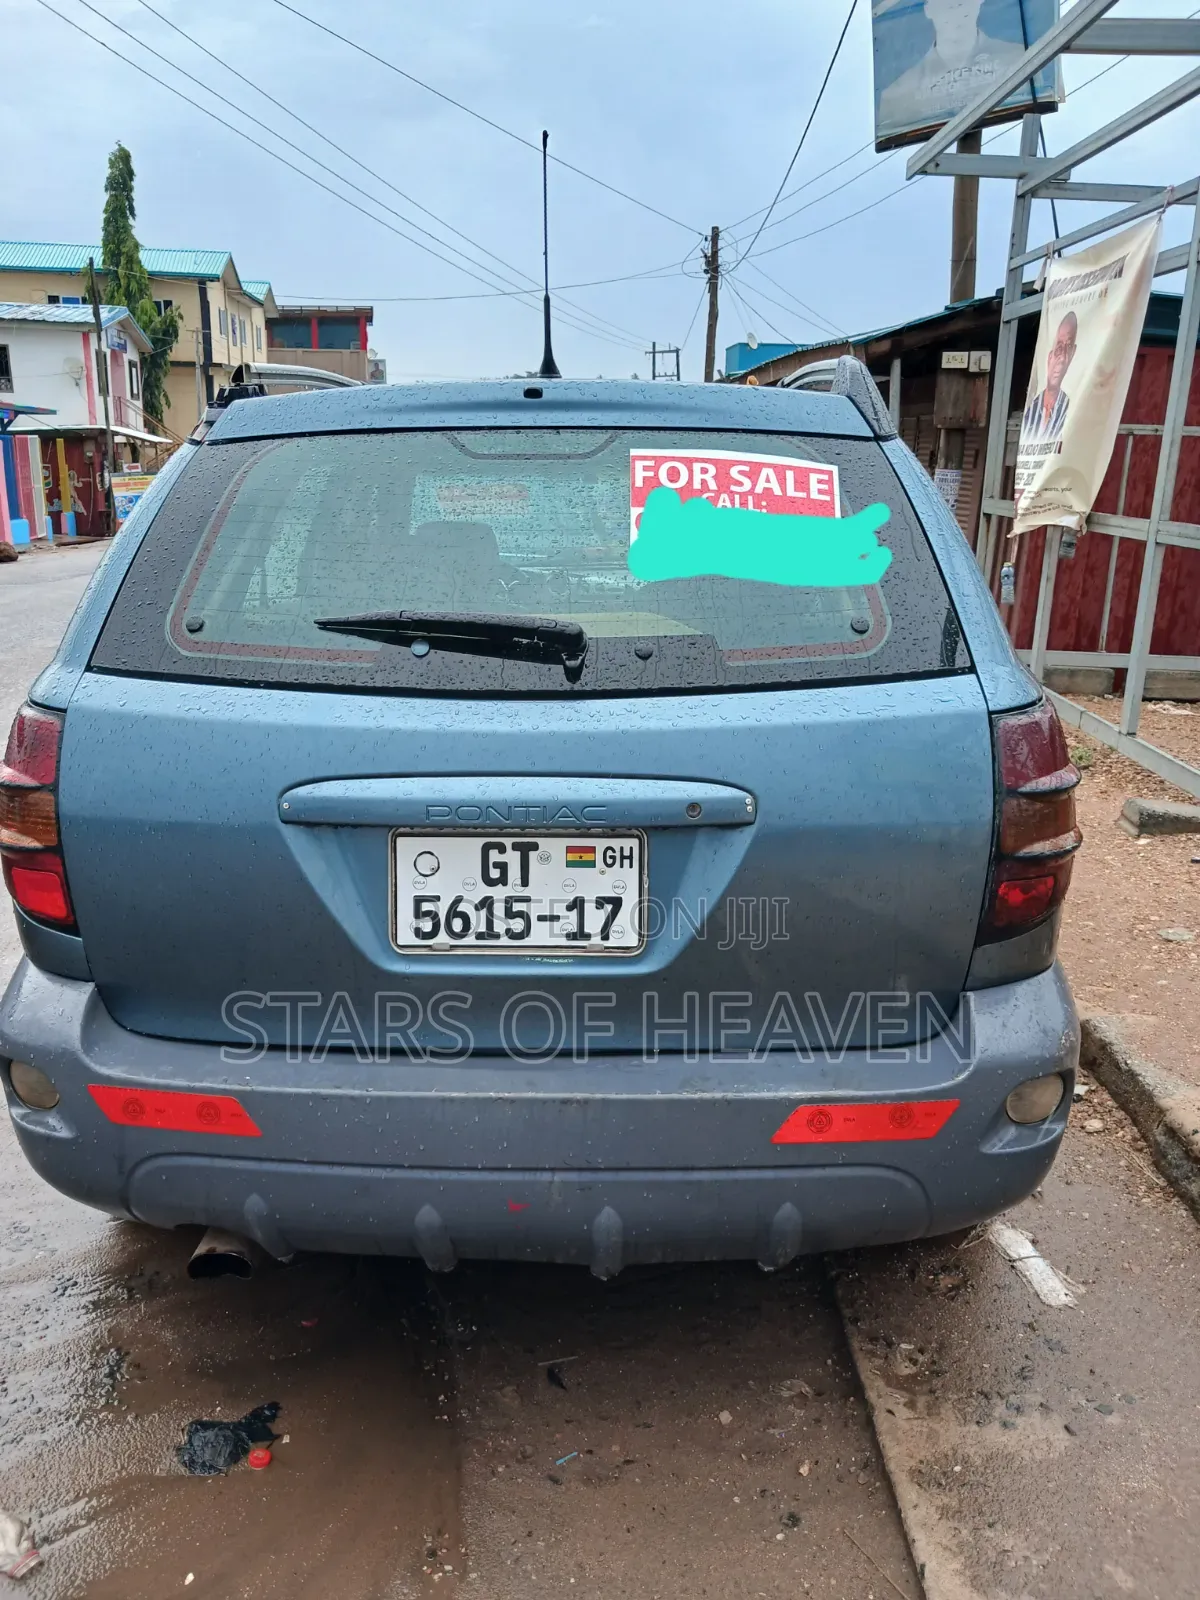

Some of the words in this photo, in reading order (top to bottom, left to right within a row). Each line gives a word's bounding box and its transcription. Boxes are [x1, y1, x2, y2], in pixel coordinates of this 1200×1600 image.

[634, 460, 718, 491] FOR
[729, 464, 831, 502] SALE
[425, 805, 608, 823] PONTIAC
[481, 841, 539, 888] GT
[602, 846, 634, 869] GH
[412, 895, 623, 941] 5615-17
